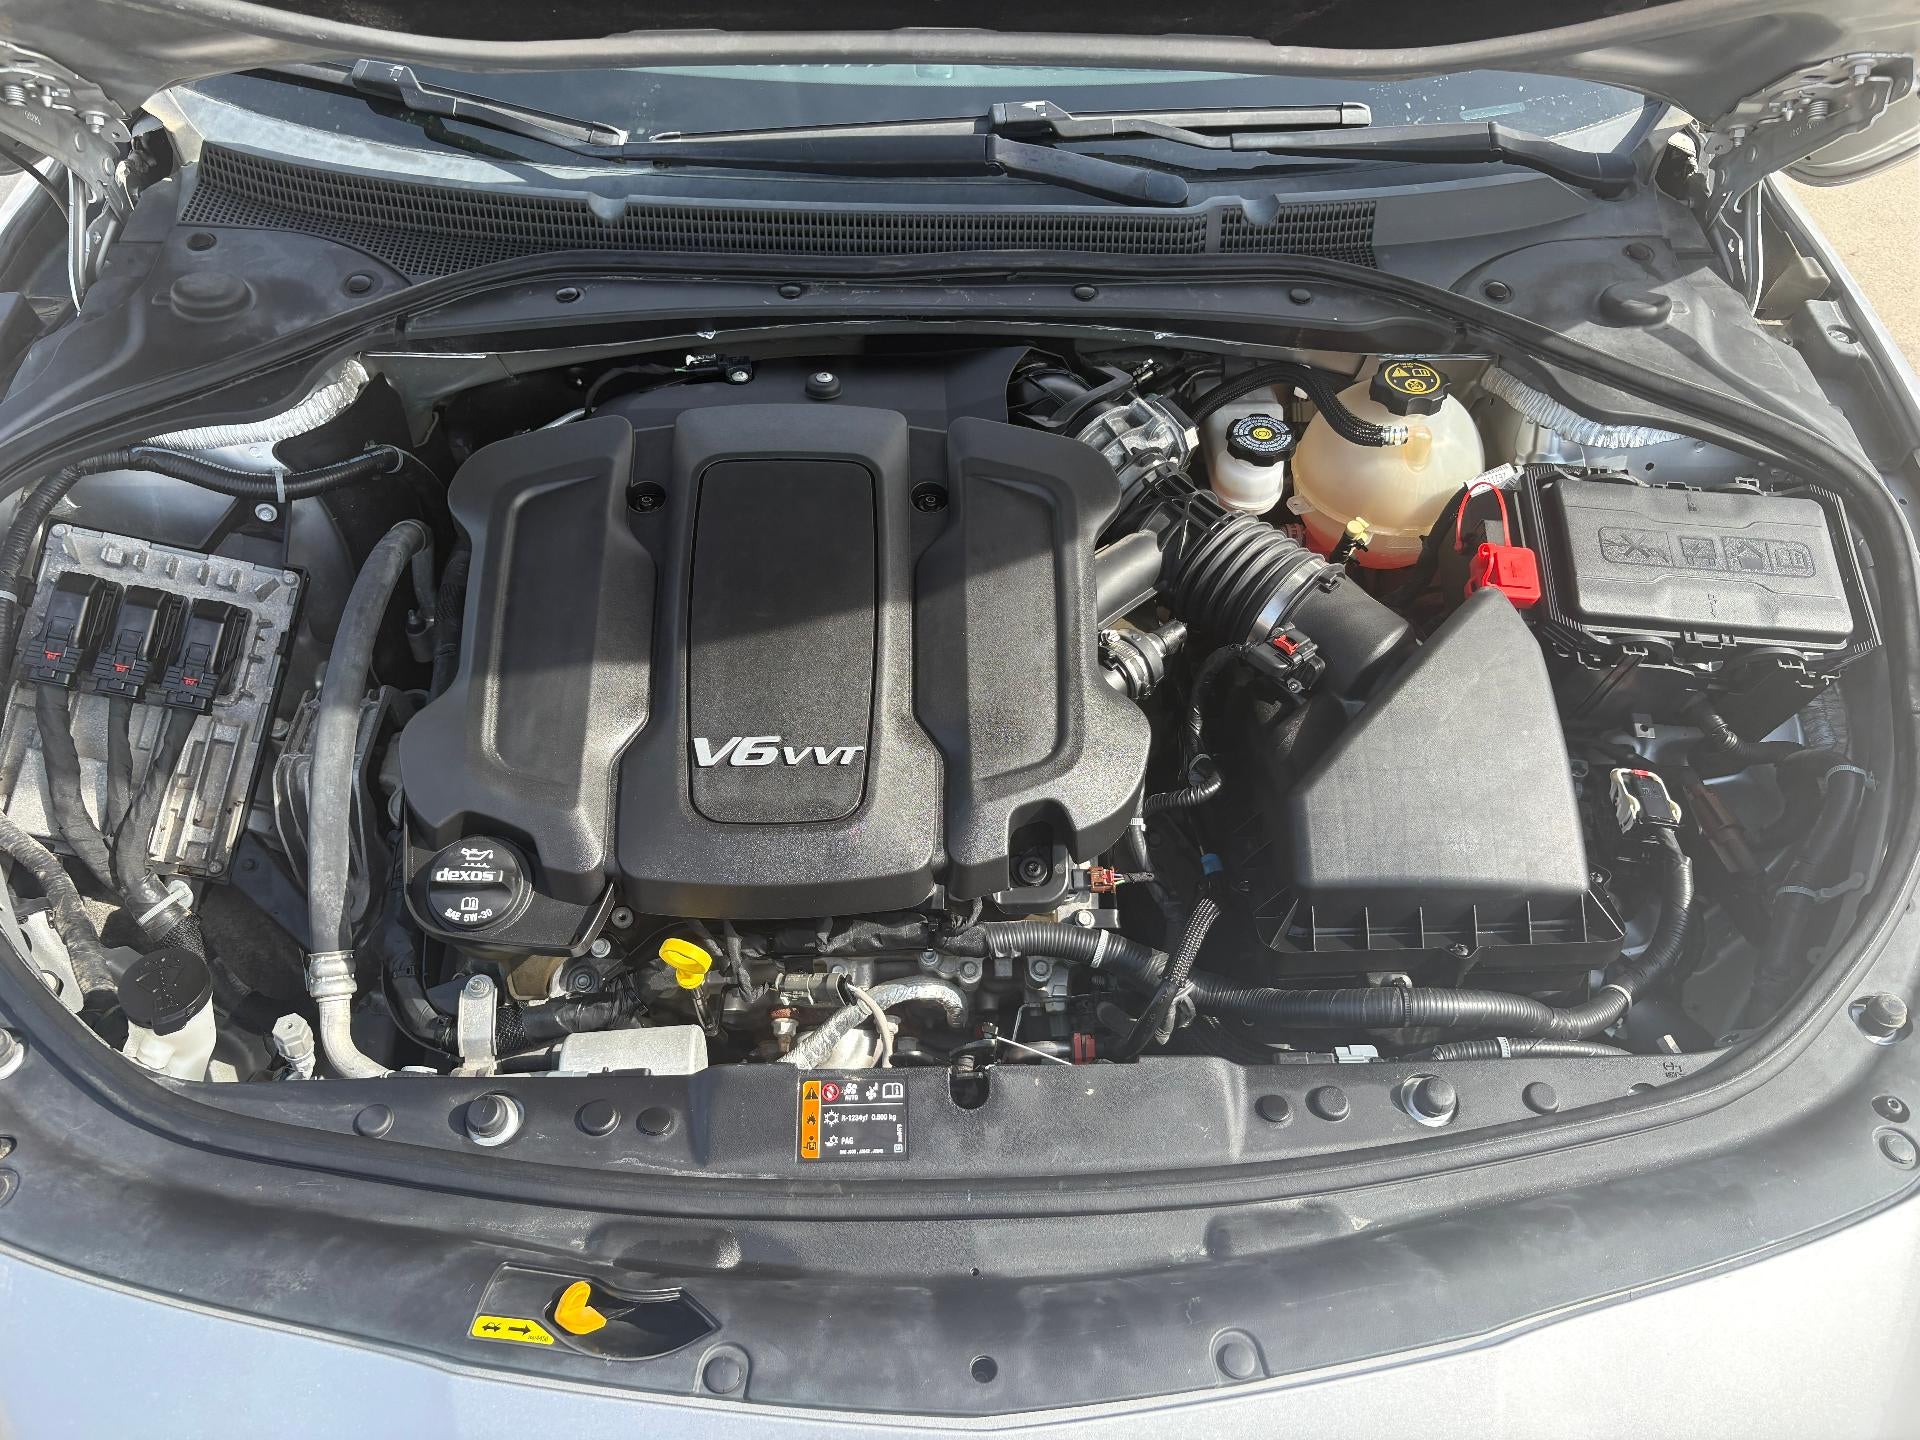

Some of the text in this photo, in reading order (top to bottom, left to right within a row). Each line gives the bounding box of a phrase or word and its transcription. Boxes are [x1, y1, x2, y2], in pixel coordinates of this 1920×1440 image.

[693, 735, 865, 767] V6 VVT
[436, 867, 496, 882] dexos
[445, 908, 493, 922] SAE 5W-30
[888, 1113, 897, 1122] kg
